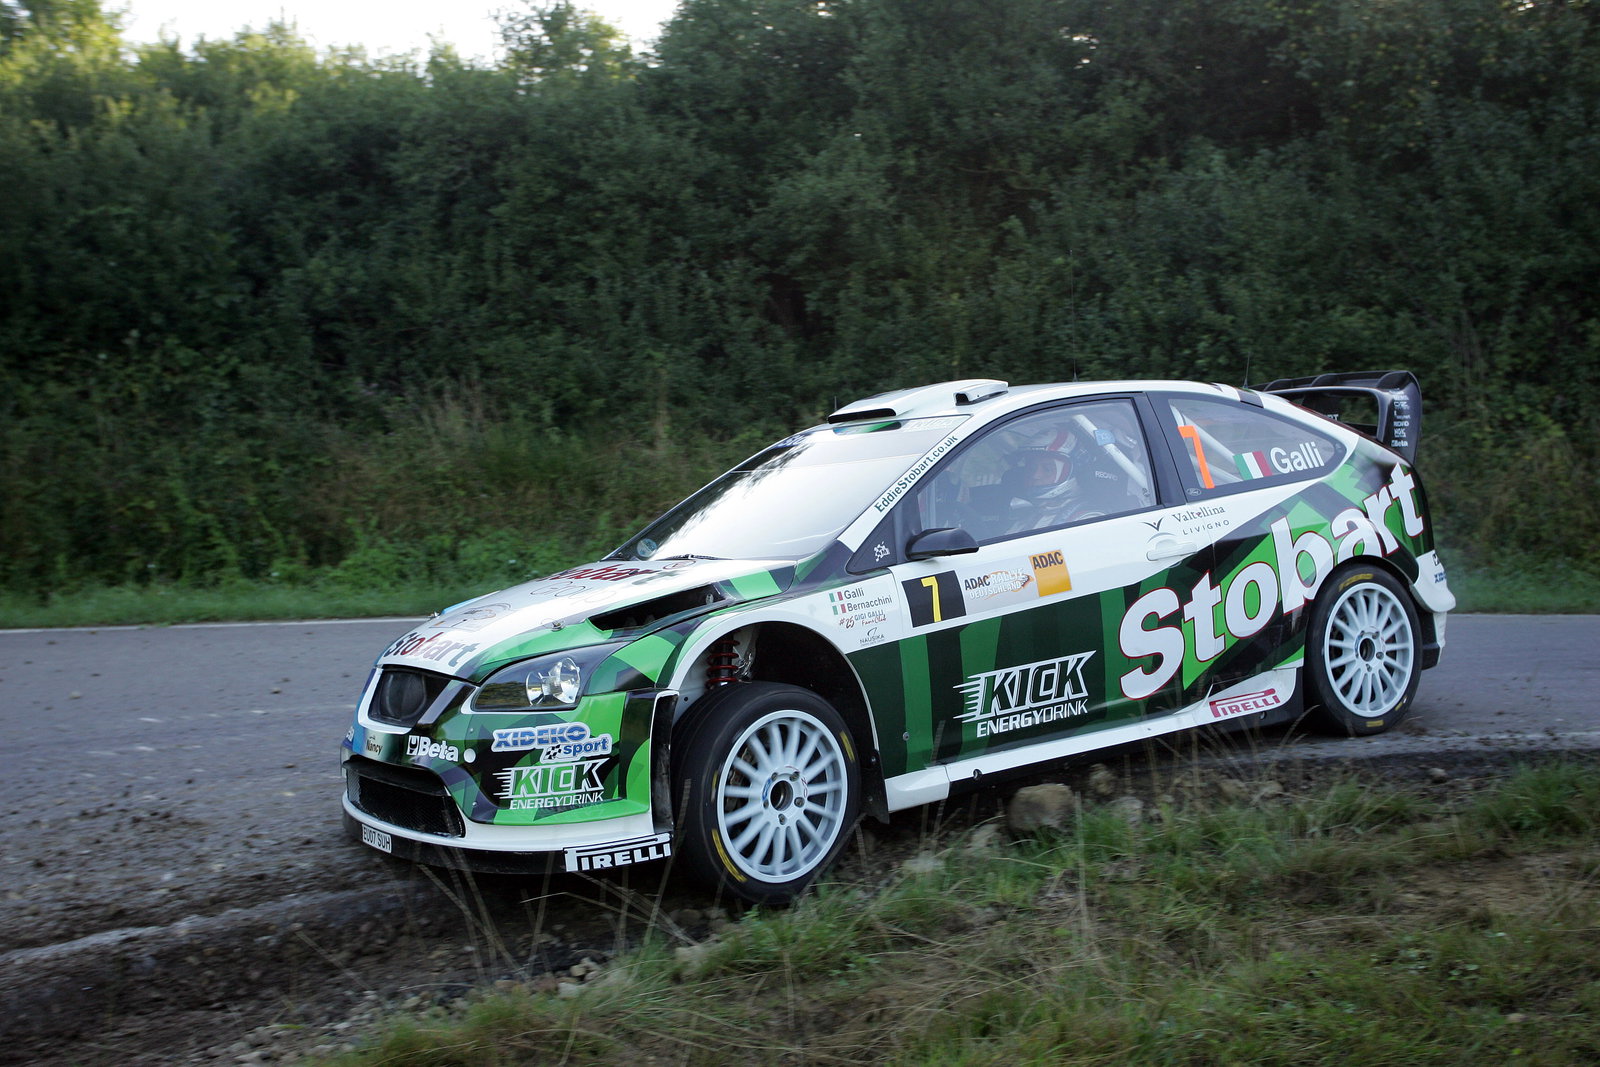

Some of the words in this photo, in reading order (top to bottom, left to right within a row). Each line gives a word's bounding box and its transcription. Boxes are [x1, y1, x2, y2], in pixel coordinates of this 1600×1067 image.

[1270, 441, 1325, 474] Galli
[874, 435, 958, 513] EddieStobart.co.uk
[1172, 504, 1226, 523] Valtellina
[1182, 519, 1231, 536] LIVIGNO
[1032, 551, 1065, 570] ADAC
[964, 575, 991, 591] ADAC
[989, 567, 1025, 585] RALLYE
[969, 580, 1022, 600] DEUTSCHLAND
[1118, 462, 1425, 700] Stobart
[843, 587, 865, 600] Galli
[846, 595, 893, 612] Bernacchini
[921, 576, 942, 623] 7
[964, 650, 1096, 722] KICK
[1208, 688, 1281, 718] PIRELLI
[494, 725, 588, 748] XIDEKO
[563, 738, 609, 757] sport
[417, 736, 459, 762] Beta
[500, 758, 609, 799] KICK
[377, 833, 391, 851] SUH
[563, 832, 672, 872] PIRELLI
